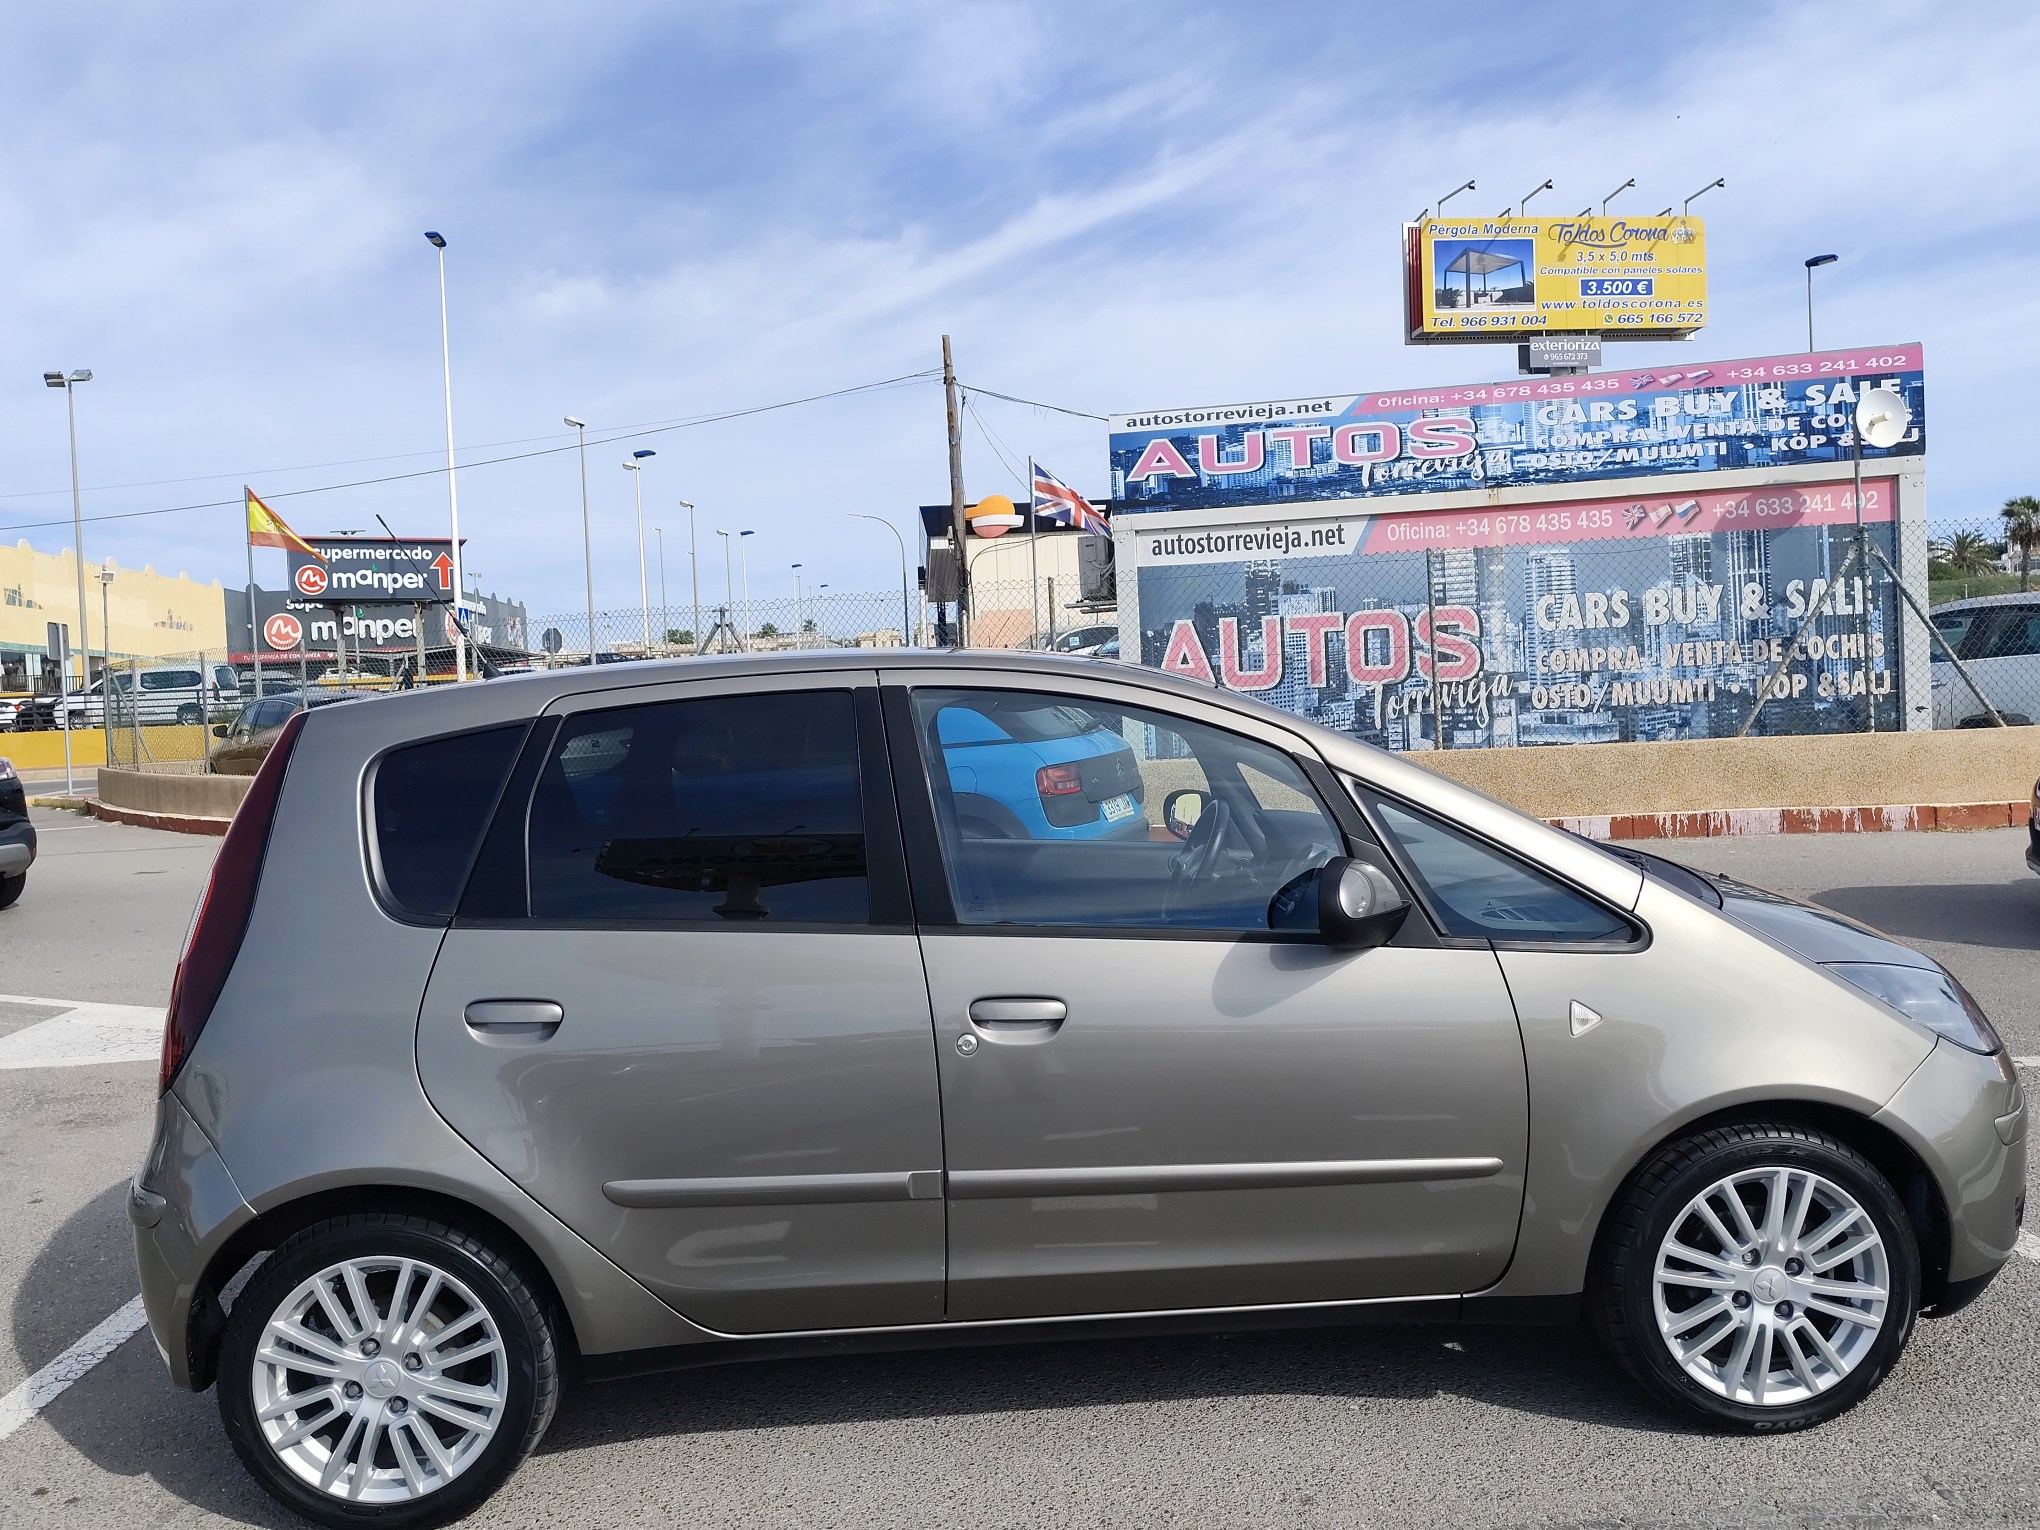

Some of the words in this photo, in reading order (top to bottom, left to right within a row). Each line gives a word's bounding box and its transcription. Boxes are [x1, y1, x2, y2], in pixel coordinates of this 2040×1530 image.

[1429, 224, 1478, 237] Pérgola
[1483, 223, 1539, 235] Moderna
[1548, 221, 1608, 248] Toldos
[1610, 221, 1669, 243] Corona
[1576, 251, 1595, 263] 3,5
[1609, 251, 1628, 263] 5,0
[1631, 251, 1658, 262] mts.
[1540, 266, 1598, 276] Compatible
[1601, 267, 1620, 275] con
[1623, 266, 1662, 276] paneles
[1666, 265, 1703, 274] solares
[1586, 280, 1633, 294] 3.500
[1636, 280, 1649, 294] €
[1541, 298, 1703, 310] www.toldoscorona.es
[1430, 317, 1456, 327] Tel.
[1460, 316, 1487, 327] 966
[1491, 315, 1516, 327] 931
[1521, 315, 1547, 326] 004
[1617, 314, 1644, 324] 665
[1649, 313, 1674, 324] 166
[1677, 313, 1703, 324] 572
[1530, 338, 1600, 351] exterioriza
[1576, 352, 1588, 360] 373
[1726, 366, 1767, 379] +34
[1772, 363, 1813, 376] 633
[1819, 359, 1860, 372] 241
[1865, 355, 1907, 368] 402
[1377, 393, 1445, 408] Oficina:
[1450, 388, 1488, 401] +34
[1493, 385, 1531, 399] 678
[1537, 382, 1575, 395] 435
[1581, 378, 1620, 391] 435
[1125, 400, 1333, 429] autostorrevieja.net
[1537, 399, 1638, 426] CARS
[1655, 391, 1739, 418] BUY
[1756, 388, 1788, 409] &
[1536, 428, 1649, 448] COMPRA
[1674, 420, 1759, 438] VENTA
[1768, 416, 1800, 432] DE
[1772, 433, 1827, 451] KÖP
[1125, 416, 1478, 483] AUTOS
[1352, 448, 1513, 488] Torrevieja
[1712, 500, 1750, 519] +34
[1755, 497, 1793, 517] 633
[1799, 494, 1836, 513] 241
[1387, 522, 1450, 541] Oficina:
[1456, 517, 1490, 536] +34
[1496, 514, 1531, 534] 678
[1536, 512, 1572, 531] 435
[1577, 509, 1613, 528] 435
[1152, 523, 1345, 557] autostorrevieja.net
[332, 569, 428, 594] manper
[1536, 590, 1630, 631] CARS
[1645, 584, 1724, 626] BUY
[1740, 581, 1771, 621] &
[1160, 604, 1484, 692] AUTOS
[1536, 645, 1642, 674] COMPRA
[1665, 640, 1744, 667] VENTA
[1752, 637, 1783, 662] DE
